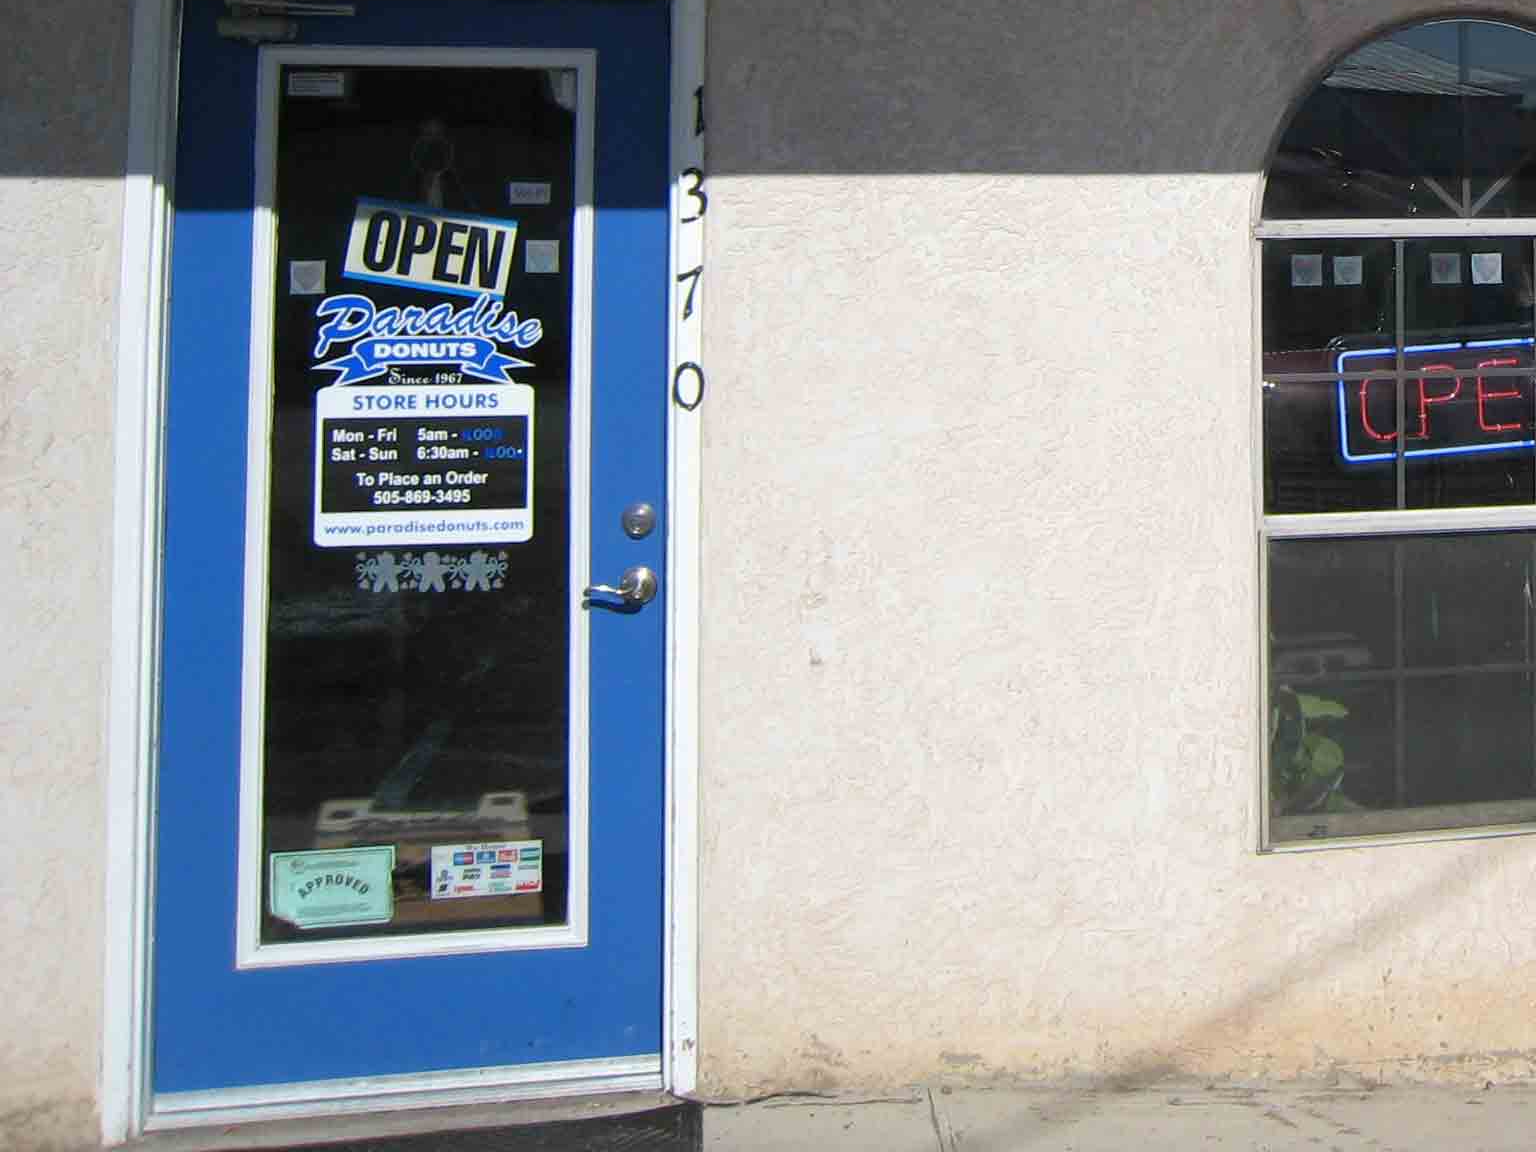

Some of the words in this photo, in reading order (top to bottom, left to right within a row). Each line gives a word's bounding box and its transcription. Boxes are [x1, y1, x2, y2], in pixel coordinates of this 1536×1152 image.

[362, 210, 507, 289] OPEN
[314, 293, 543, 358] Paradise
[373, 342, 477, 358] DONUTS
[388, 366, 431, 385] Since
[434, 372, 463, 384] 1967
[353, 394, 417, 410] STORE
[425, 393, 499, 409] HOURS
[332, 428, 364, 443] Mon
[377, 427, 397, 442] Fri
[417, 427, 448, 442] 5am
[331, 447, 357, 462] Sat
[369, 446, 398, 461] Sun
[416, 446, 470, 460] 6:30am
[356, 472, 375, 487] To
[379, 471, 420, 486] Place
[423, 474, 441, 485] an
[445, 470, 489, 485] Order
[373, 489, 472, 505] 505-869-3495
[324, 519, 525, 536] www.paradisedonuts.com
[297, 872, 370, 900] APPROVED
